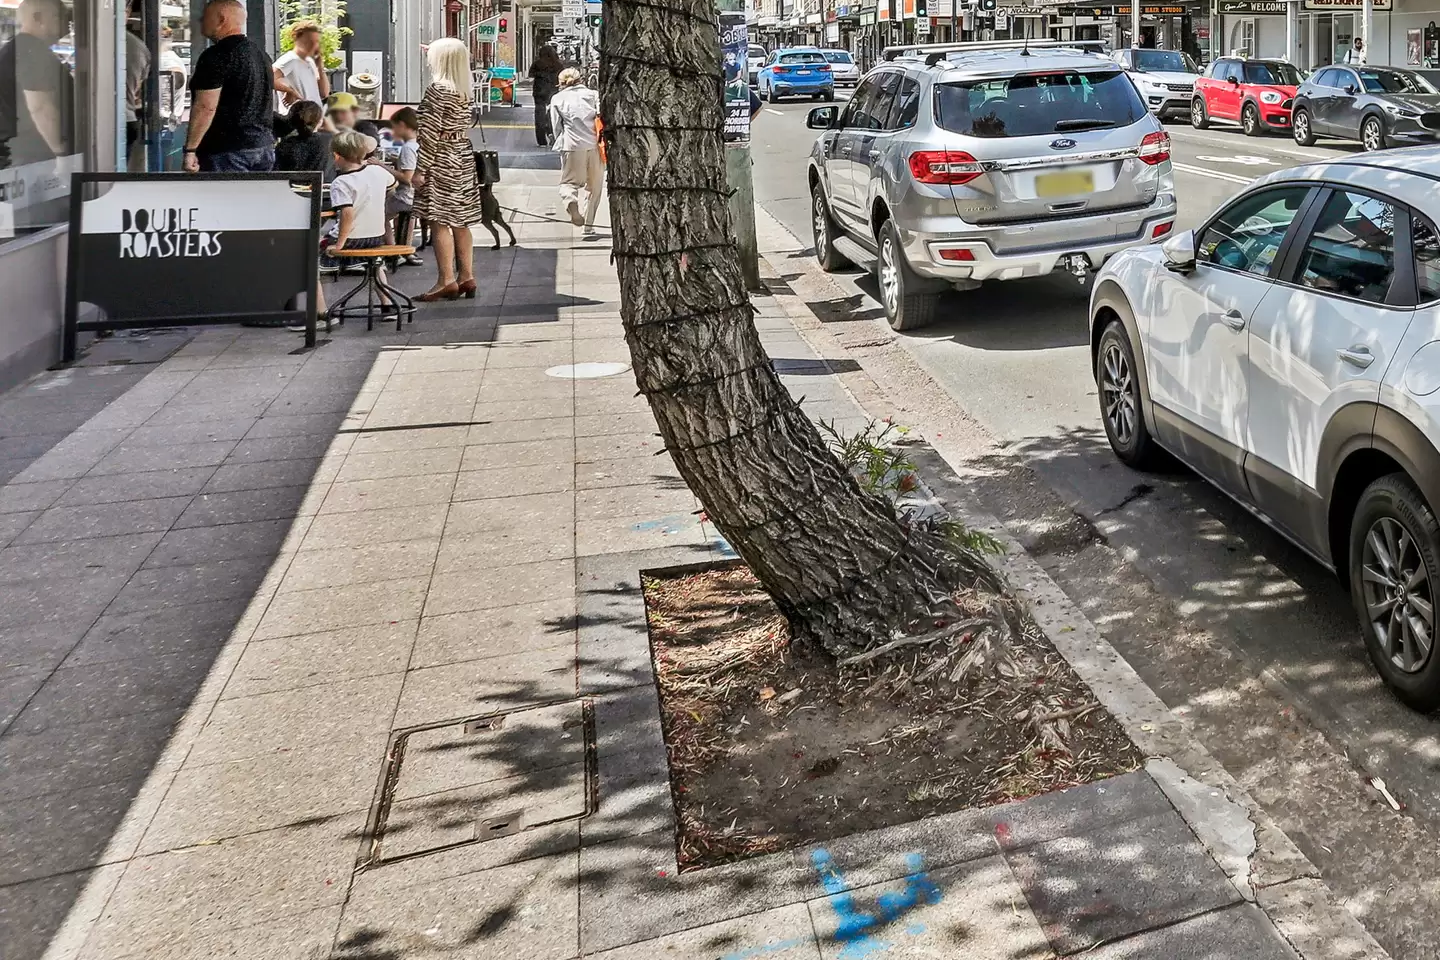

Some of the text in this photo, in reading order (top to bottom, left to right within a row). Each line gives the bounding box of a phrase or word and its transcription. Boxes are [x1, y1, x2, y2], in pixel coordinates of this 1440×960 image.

[1250, 2, 1287, 12] WELCOME
[478, 25, 496, 35] OPEN
[730, 109, 740, 117] 24
[122, 208, 198, 233] DOUBLE
[120, 232, 223, 258] ROASTERS
